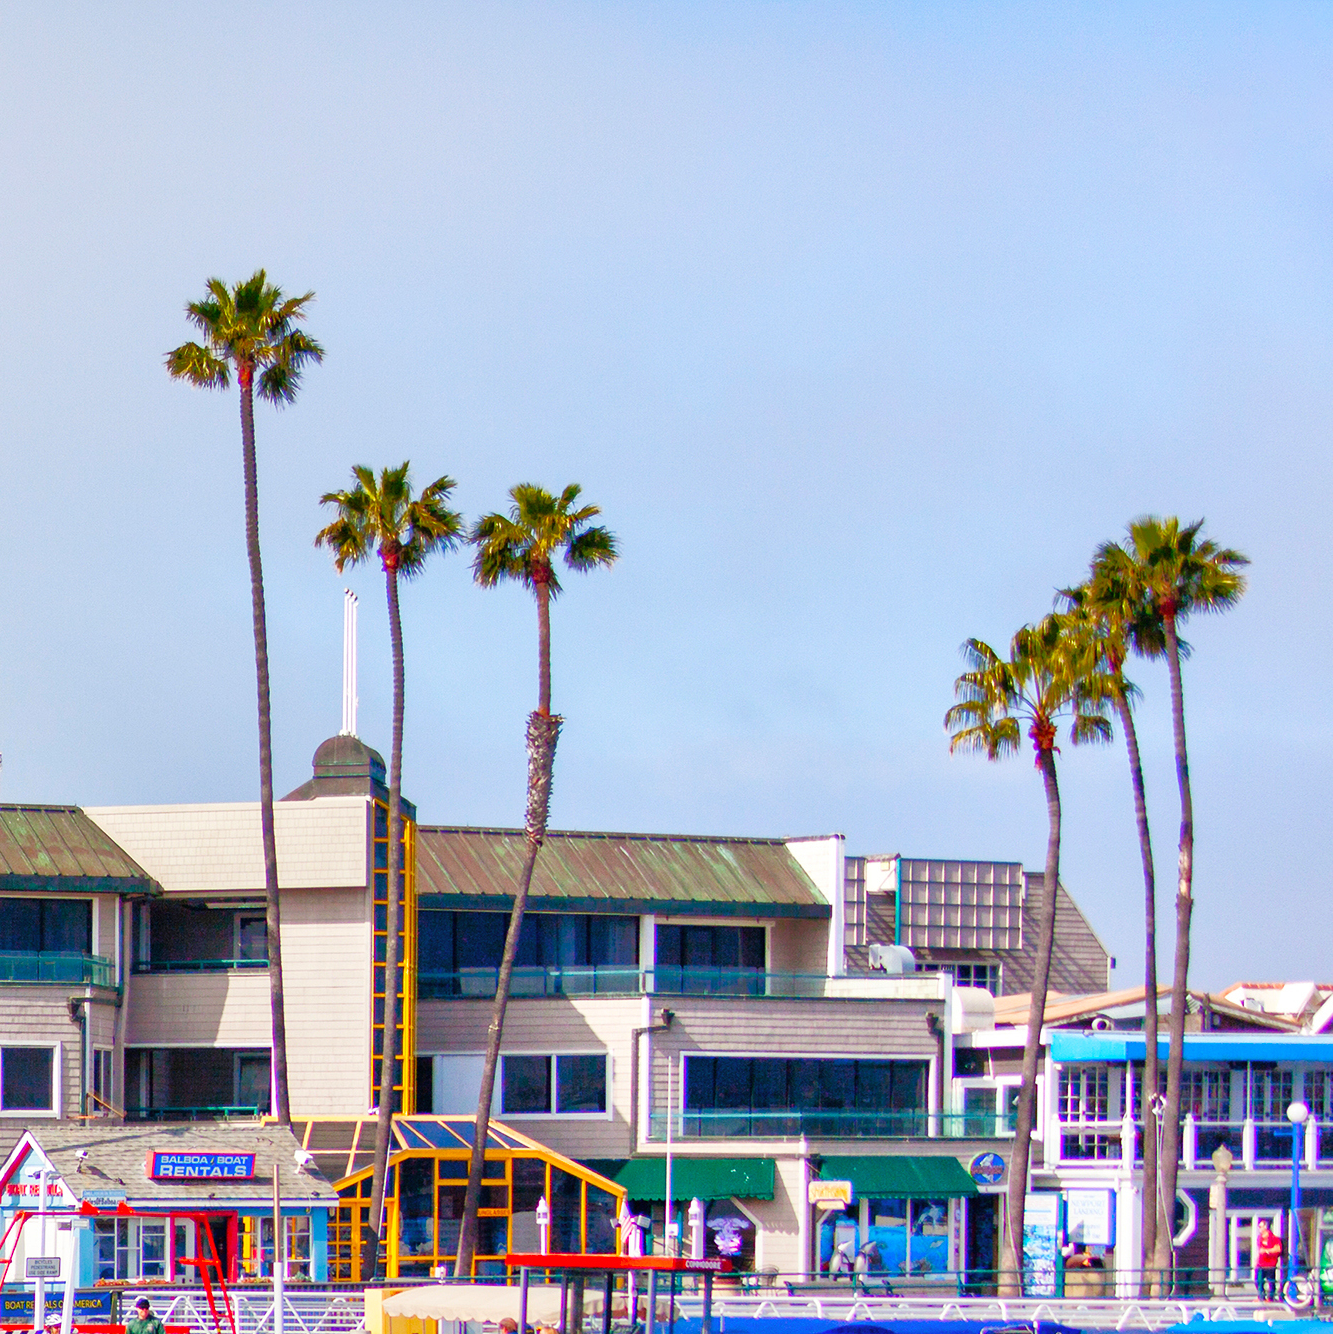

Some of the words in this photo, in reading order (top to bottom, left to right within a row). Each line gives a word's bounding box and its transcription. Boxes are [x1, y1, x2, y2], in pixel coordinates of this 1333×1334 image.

[160, 1155, 209, 1164] BALBOA
[217, 1156, 248, 1165] BOAT
[159, 1164, 247, 1177] RENTALS
[1073, 1207, 1104, 1215] LANDING
[685, 1259, 722, 1270] COMMODORE
[5, 1300, 25, 1310] BOAT
[26, 1300, 58, 1310] REALS
[73, 1299, 102, 1308] MERICA
